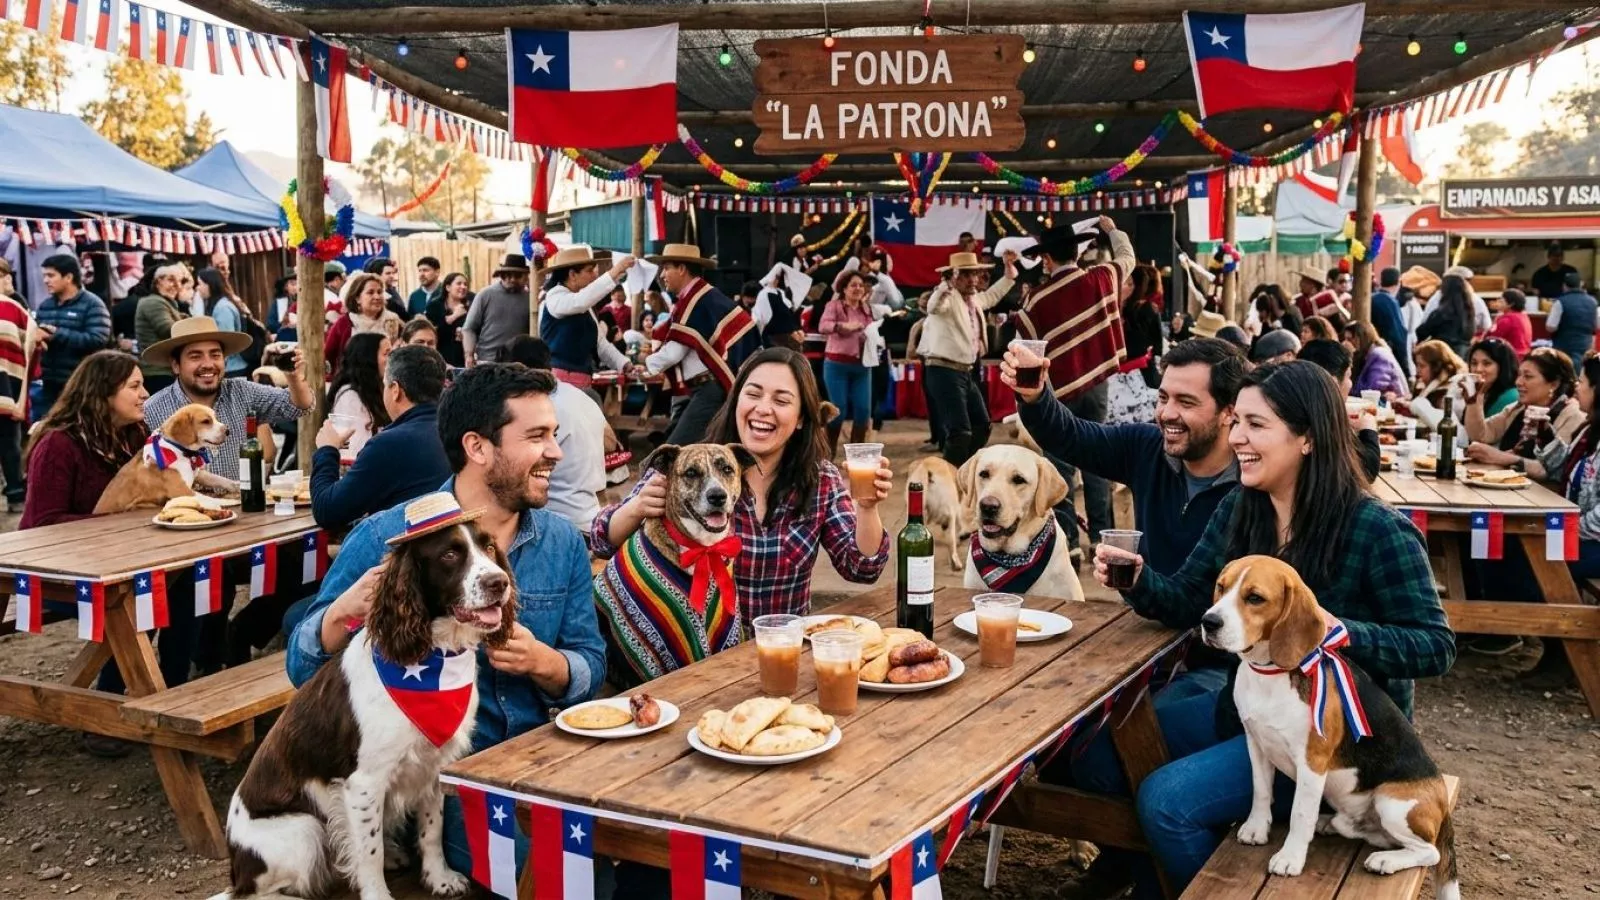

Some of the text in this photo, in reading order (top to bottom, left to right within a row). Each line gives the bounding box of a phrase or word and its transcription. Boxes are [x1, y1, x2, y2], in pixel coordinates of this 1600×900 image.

[830, 49, 953, 87] FONDA
[766, 95, 1008, 140] “LA PATRONA”
[1447, 184, 1600, 208] EMPANADAS Y ASA
